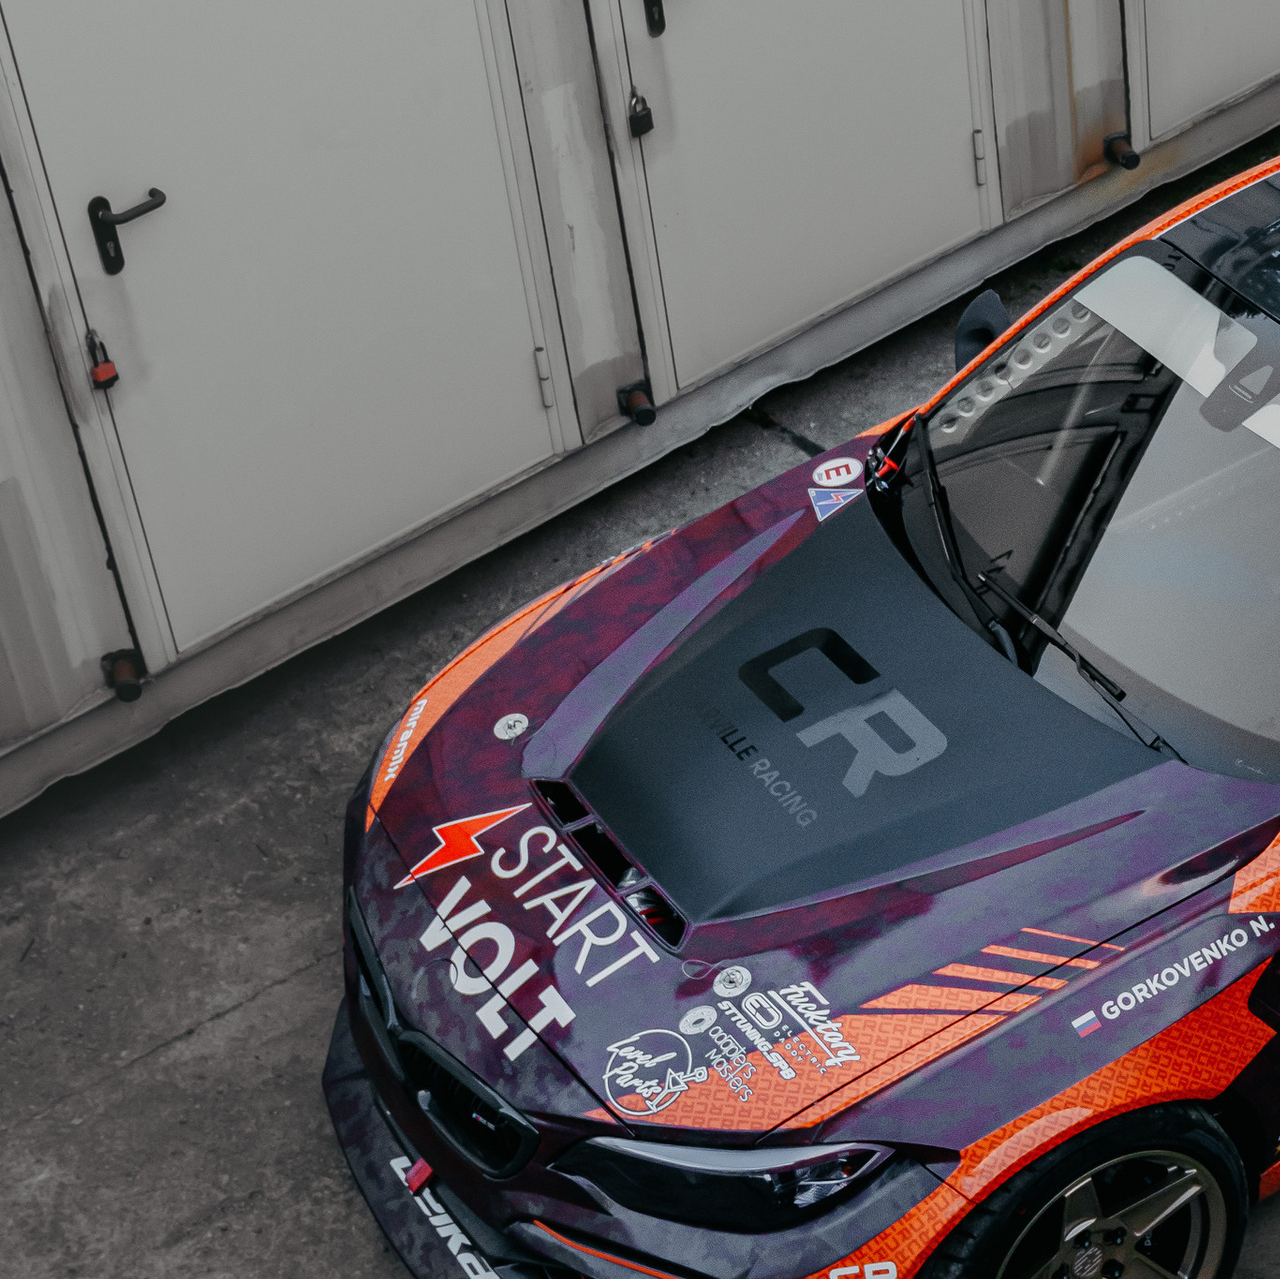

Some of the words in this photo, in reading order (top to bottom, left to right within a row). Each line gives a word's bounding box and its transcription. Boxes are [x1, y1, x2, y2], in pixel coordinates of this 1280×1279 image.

[738, 627, 948, 799] CR
[750, 757, 818, 828] RACING
[490, 825, 661, 988] START
[419, 875, 577, 1062] VOLT
[1101, 928, 1250, 1021] GORKOVENKO
[1249, 915, 1276, 939] N.
[606, 1035, 677, 1068] Level
[708, 1025, 757, 1080] adapters
[768, 981, 861, 1068] Fucktory
[773, 1030, 804, 1063] DADDY
[781, 1024, 827, 1075] ELECTRIC
[602, 1061, 663, 1099] Parts
